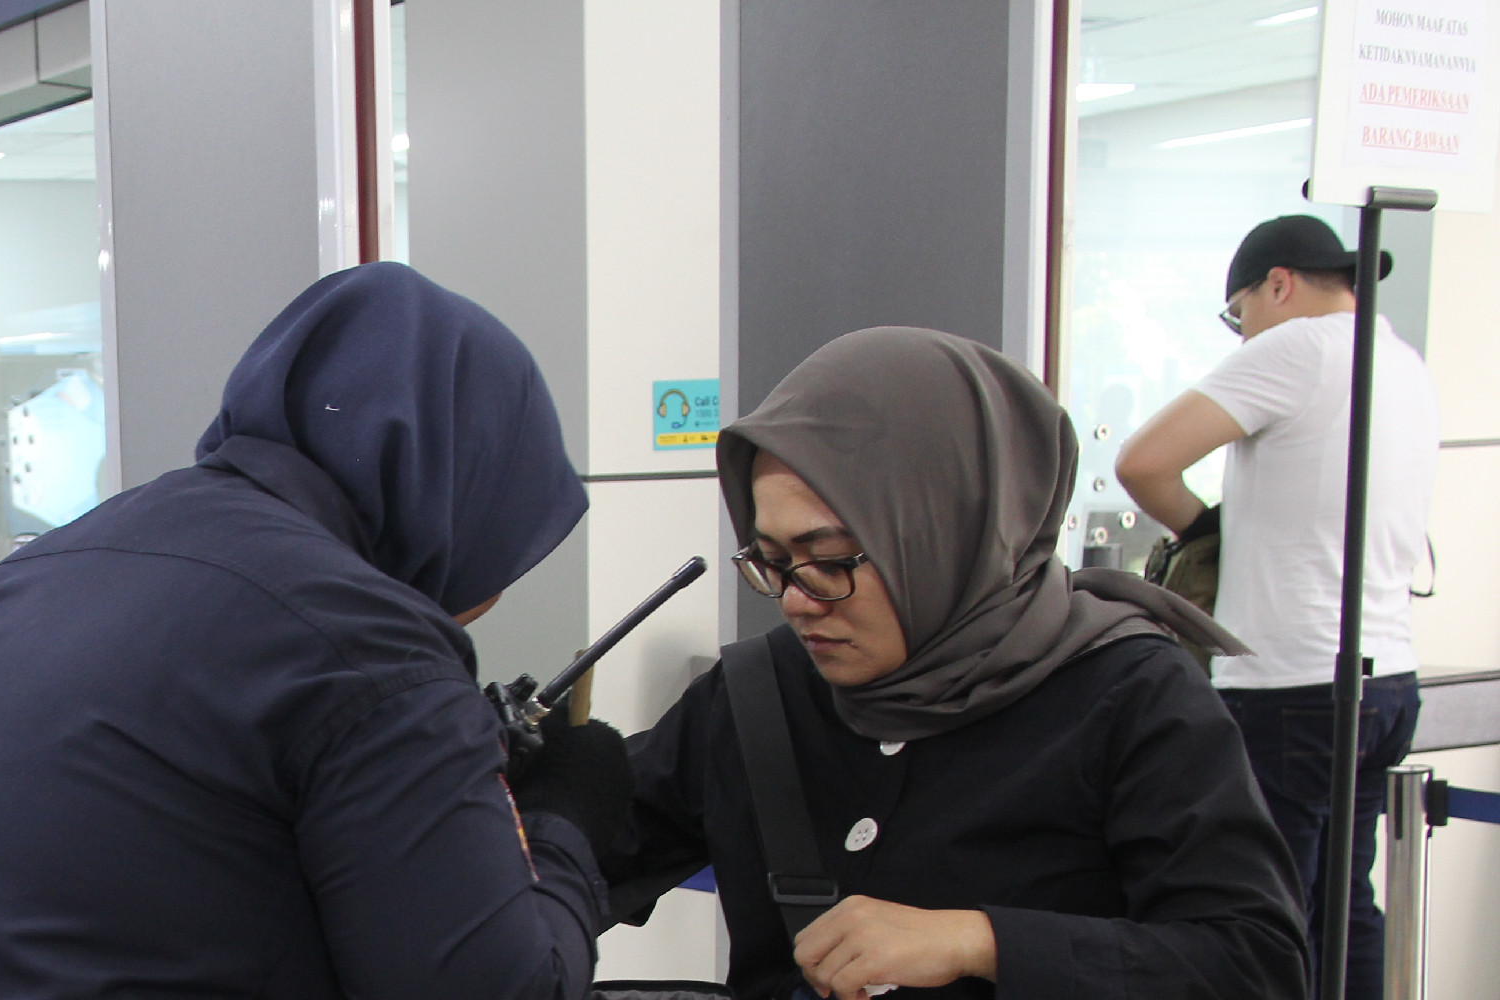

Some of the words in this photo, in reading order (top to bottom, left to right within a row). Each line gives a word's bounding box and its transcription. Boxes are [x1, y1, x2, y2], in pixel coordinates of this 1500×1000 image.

[1375, 9, 1414, 28] MOHON
[1416, 15, 1443, 33] MAAF
[1445, 20, 1469, 36] ATAS
[1360, 83, 1385, 102] ADA
[1388, 85, 1469, 110] PEMERIKSAAN
[1362, 125, 1412, 147] BARANG
[1415, 130, 1460, 151] BAWAAN
